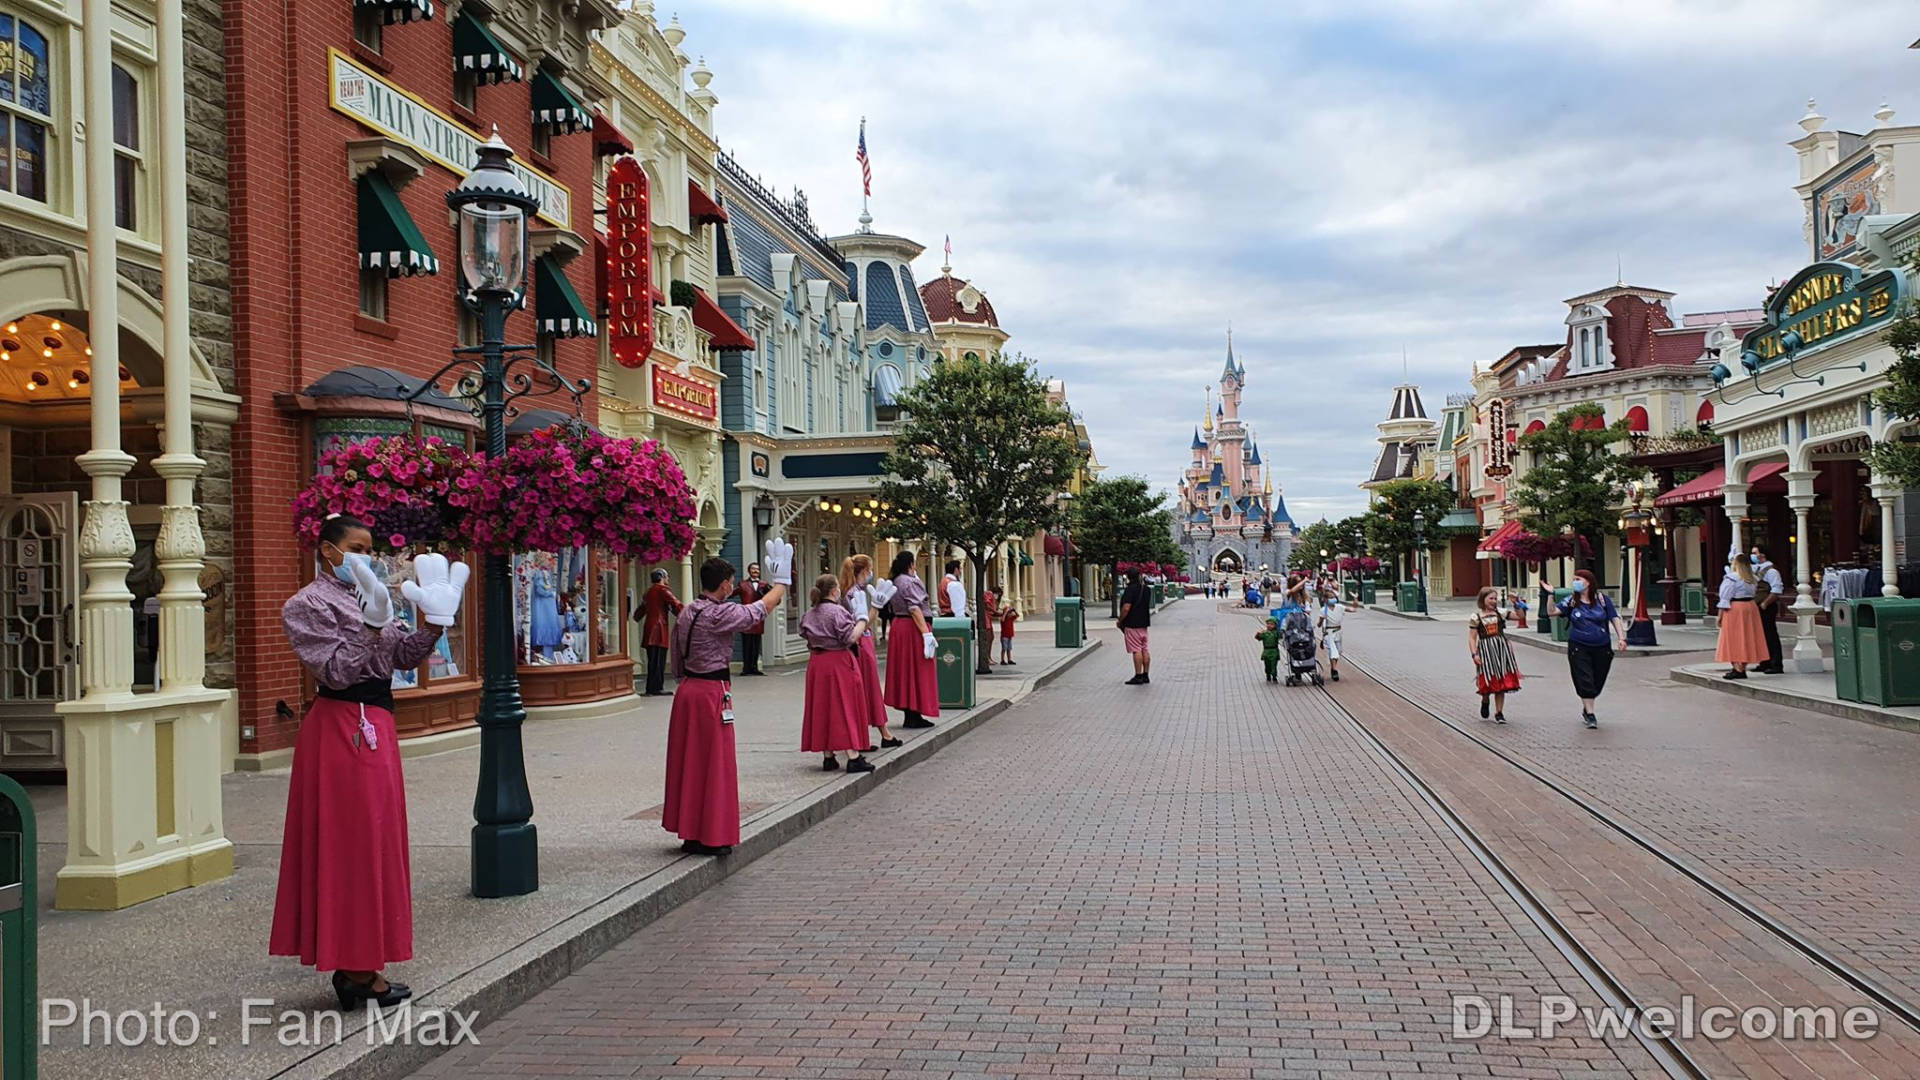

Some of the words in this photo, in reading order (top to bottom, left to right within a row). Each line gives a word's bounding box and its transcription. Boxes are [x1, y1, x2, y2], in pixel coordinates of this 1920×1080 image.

[367, 80, 416, 140] MAIN
[617, 182, 639, 338] EMPORIUM
[1788, 273, 1844, 316] DISNEY
[663, 380, 713, 409] EMPORIUM
